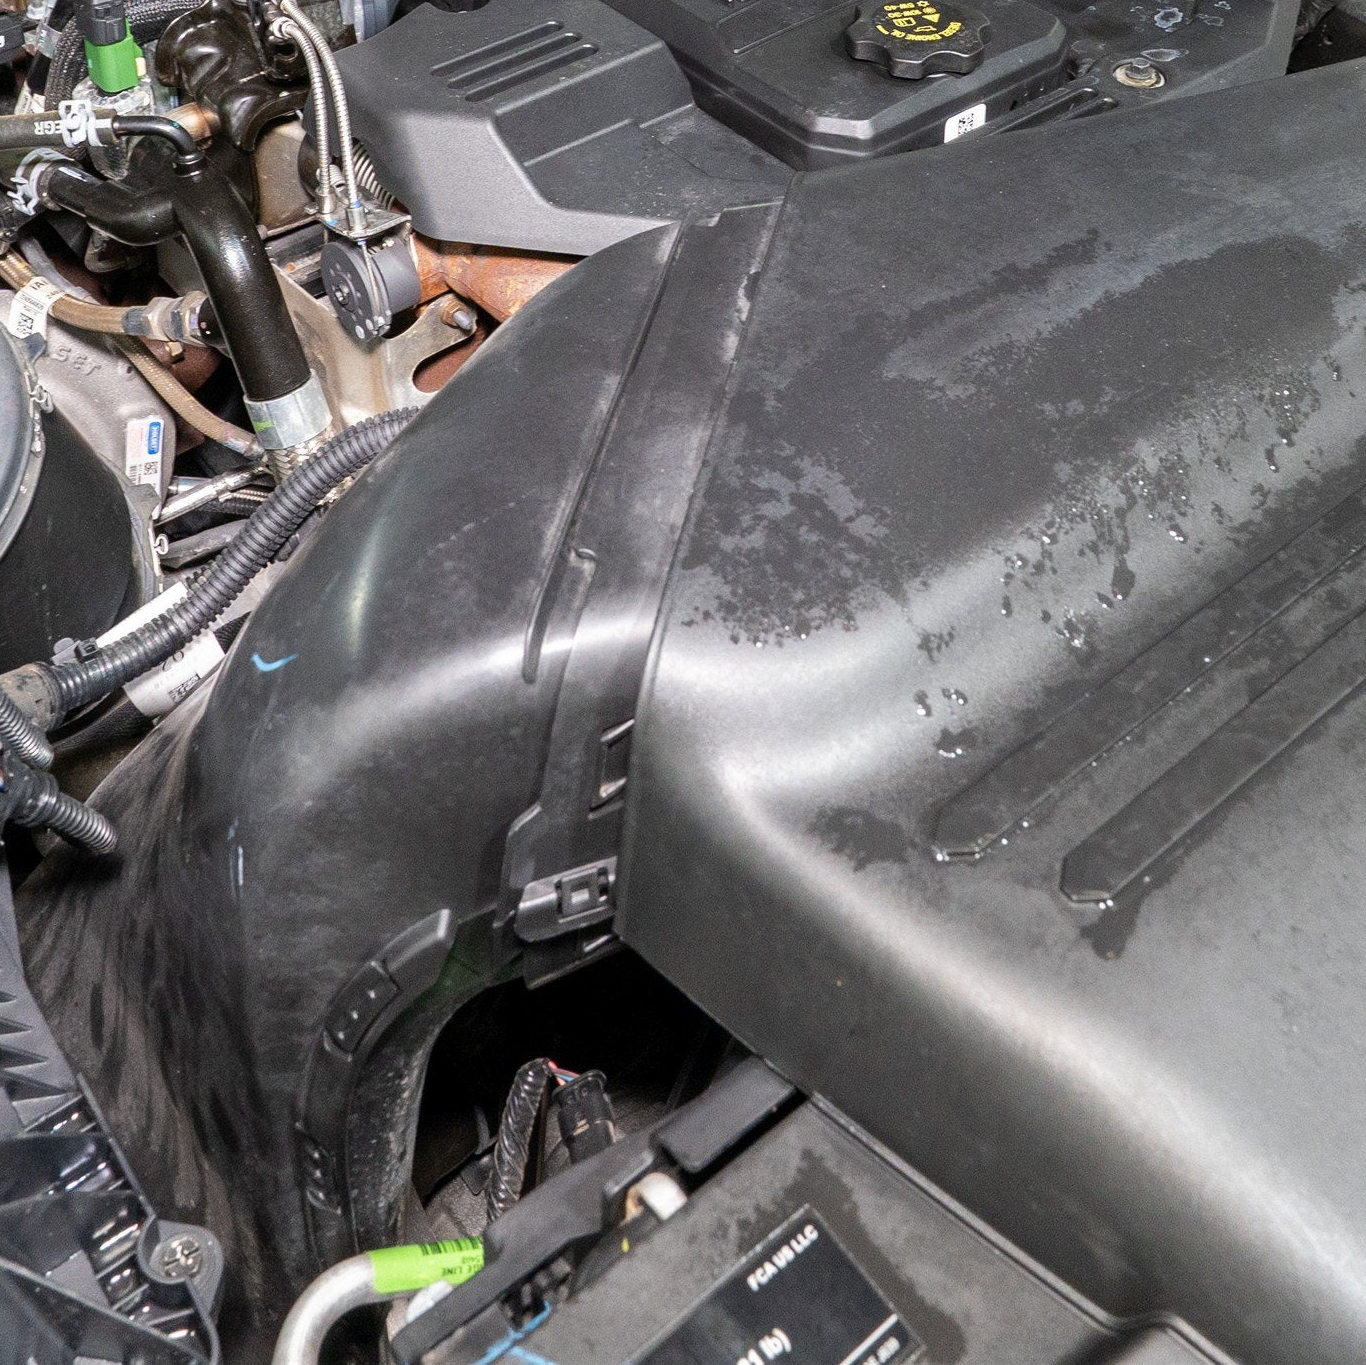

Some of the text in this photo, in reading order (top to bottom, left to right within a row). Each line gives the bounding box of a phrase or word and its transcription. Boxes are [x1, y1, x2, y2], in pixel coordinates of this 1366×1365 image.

[34, 120, 63, 135] EGR
[53, 346, 102, 376] SET
[747, 1224, 819, 1292] FCA US LLC
